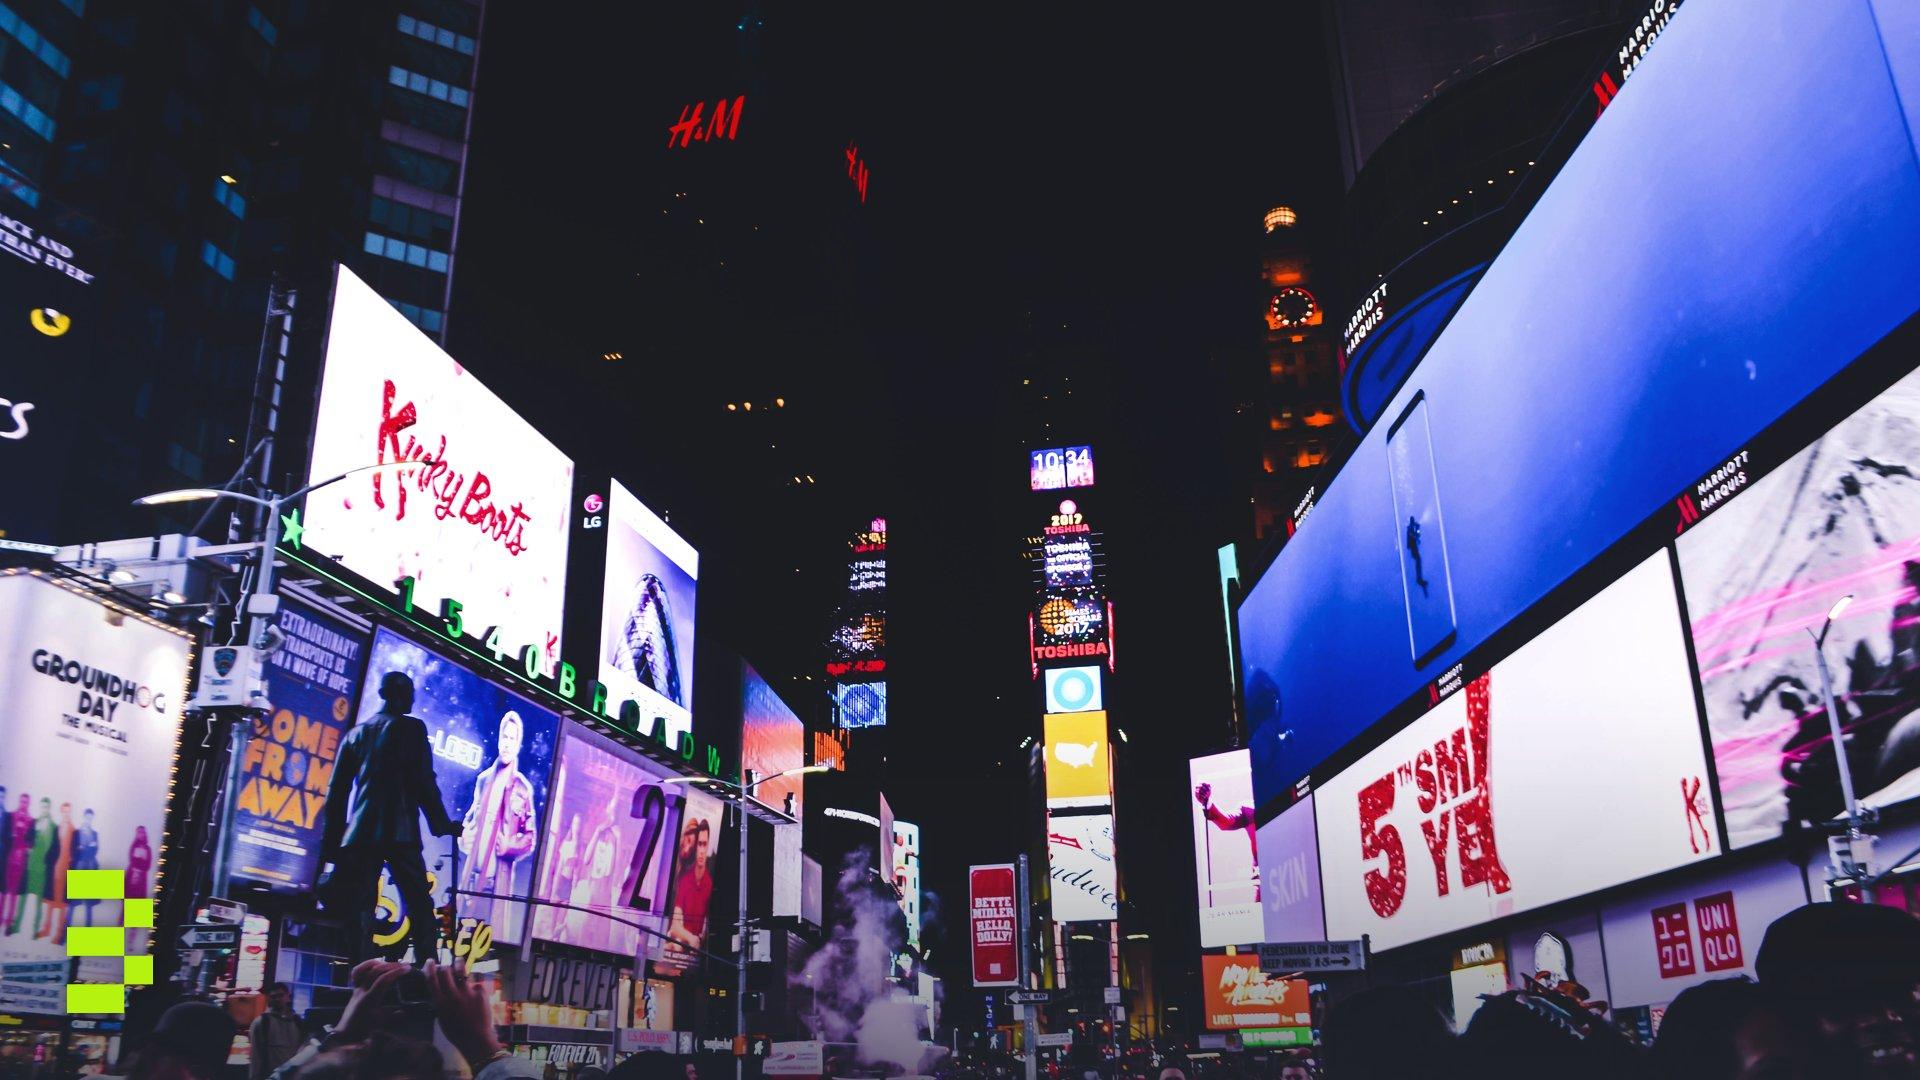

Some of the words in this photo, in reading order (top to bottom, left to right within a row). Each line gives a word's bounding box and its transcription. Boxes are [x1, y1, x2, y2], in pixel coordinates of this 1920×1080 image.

[669, 95, 745, 149] H&M
[0, 212, 34, 240] ACK
[37, 235, 74, 258] AND
[1344, 283, 1387, 342] MARRIOTT
[1346, 306, 1383, 358] MARQUIS
[373, 379, 463, 521] Kinky
[1034, 448, 1090, 473] 10:34
[1697, 451, 1748, 496] MARRIOTT
[1700, 471, 1747, 511] MARQUIS
[460, 471, 531, 556] Boots
[583, 515, 602, 529] LG
[1051, 513, 1083, 527] 2017
[1044, 524, 1090, 535] TOSHIBA
[1054, 622, 1089, 635] 2017
[285, 633, 335, 669] TRANSPORTS
[1035, 642, 1108, 659] TOSHIBA
[31, 648, 166, 714] GROUNDHOG
[293, 656, 318, 681] WAVE
[77, 690, 120, 723] DAY
[61, 713, 80, 729] THE
[83, 721, 128, 743] MUSICAL
[243, 737, 333, 797] FROM
[238, 778, 325, 830] AWAY
[1049, 852, 1118, 912] udwe
[1269, 851, 1309, 912] SKIN
[973, 908, 1014, 919] MIDLER
[975, 897, 1011, 908] BETTE
[1700, 903, 1730, 931] UNI
[976, 920, 1013, 931] HELLO,
[976, 932, 1012, 943] DOLLY!
[1262, 958, 1282, 969] KEEP
[1282, 957, 1311, 969] MOVING
[1309, 943, 1329, 955] FLOW
[1330, 942, 1350, 954] ZONE
[1705, 934, 1737, 966] QLO
[528, 955, 617, 1011] FOREVER
[1019, 993, 1030, 1001] ONE
[1033, 993, 1047, 1001] WAY
[547, 1044, 586, 1063] FOREVER
